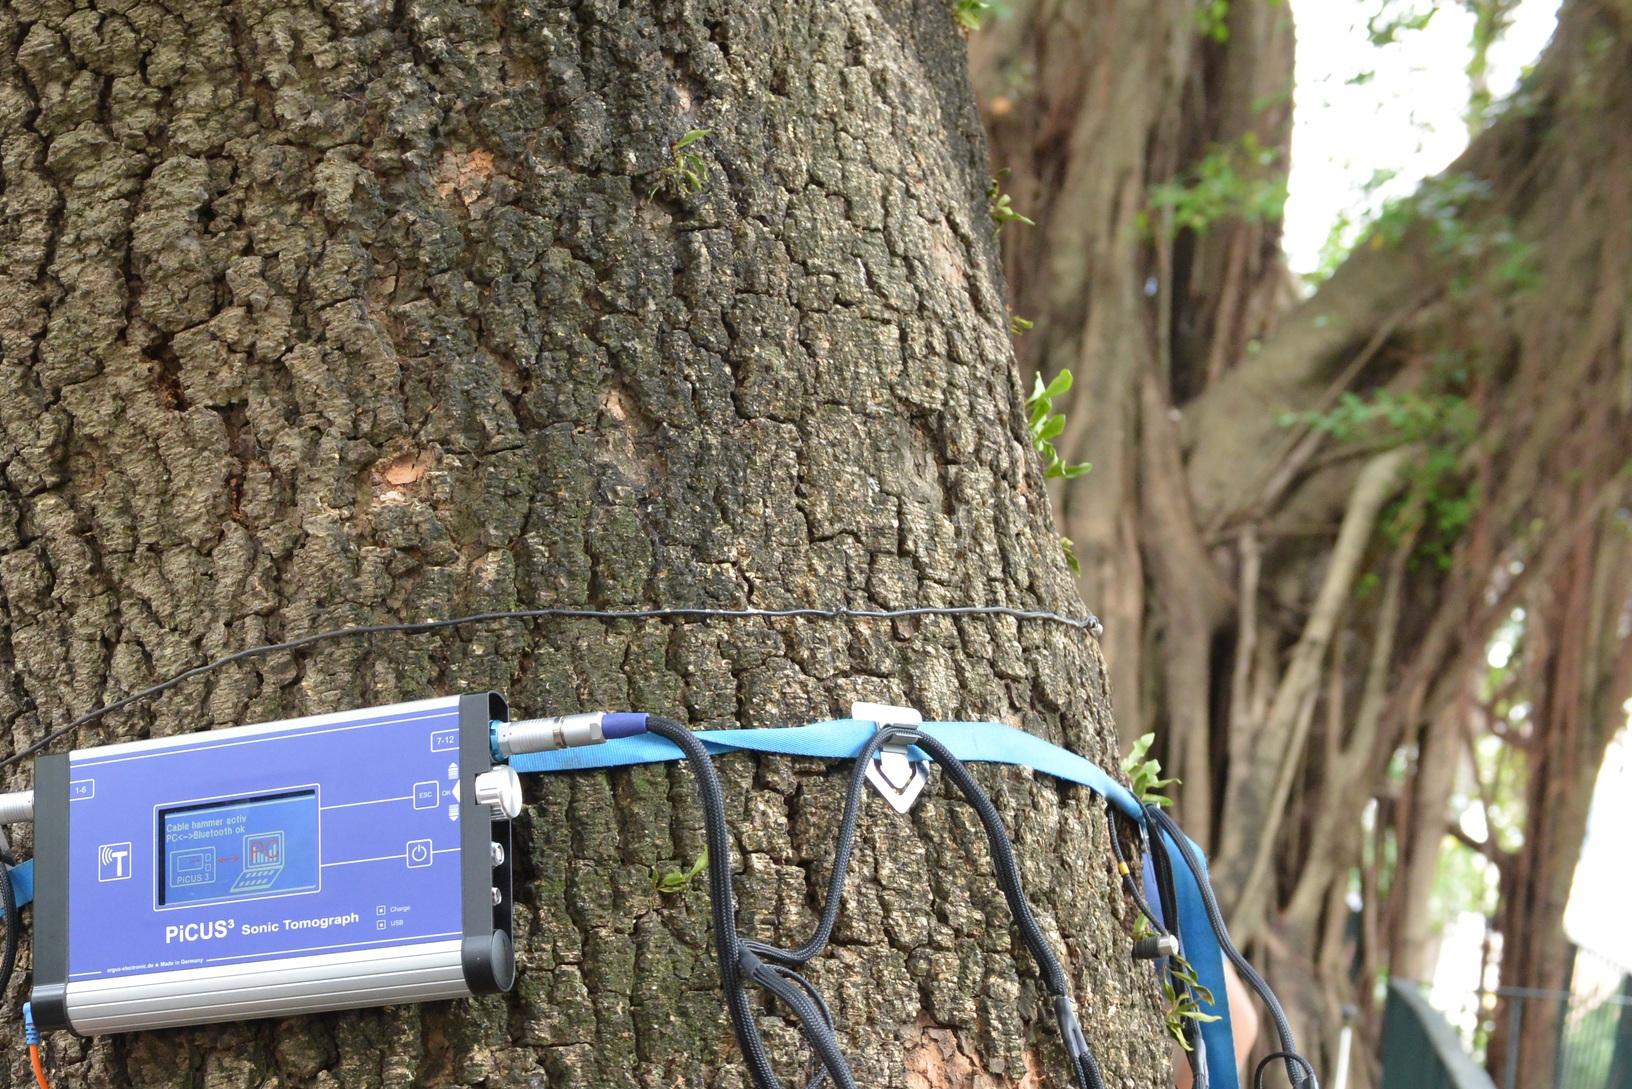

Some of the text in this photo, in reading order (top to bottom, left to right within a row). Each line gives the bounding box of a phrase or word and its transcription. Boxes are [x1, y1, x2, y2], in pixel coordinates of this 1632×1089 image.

[436, 735, 454, 745] 7-12
[75, 785, 87, 794] 1-6
[419, 791, 433, 799] ESC
[166, 815, 247, 833] Cable hammer activ
[235, 824, 246, 834] ok
[176, 872, 210, 885] PiCUS 3
[241, 921, 279, 935] Sonic
[282, 912, 360, 931] Tomograph
